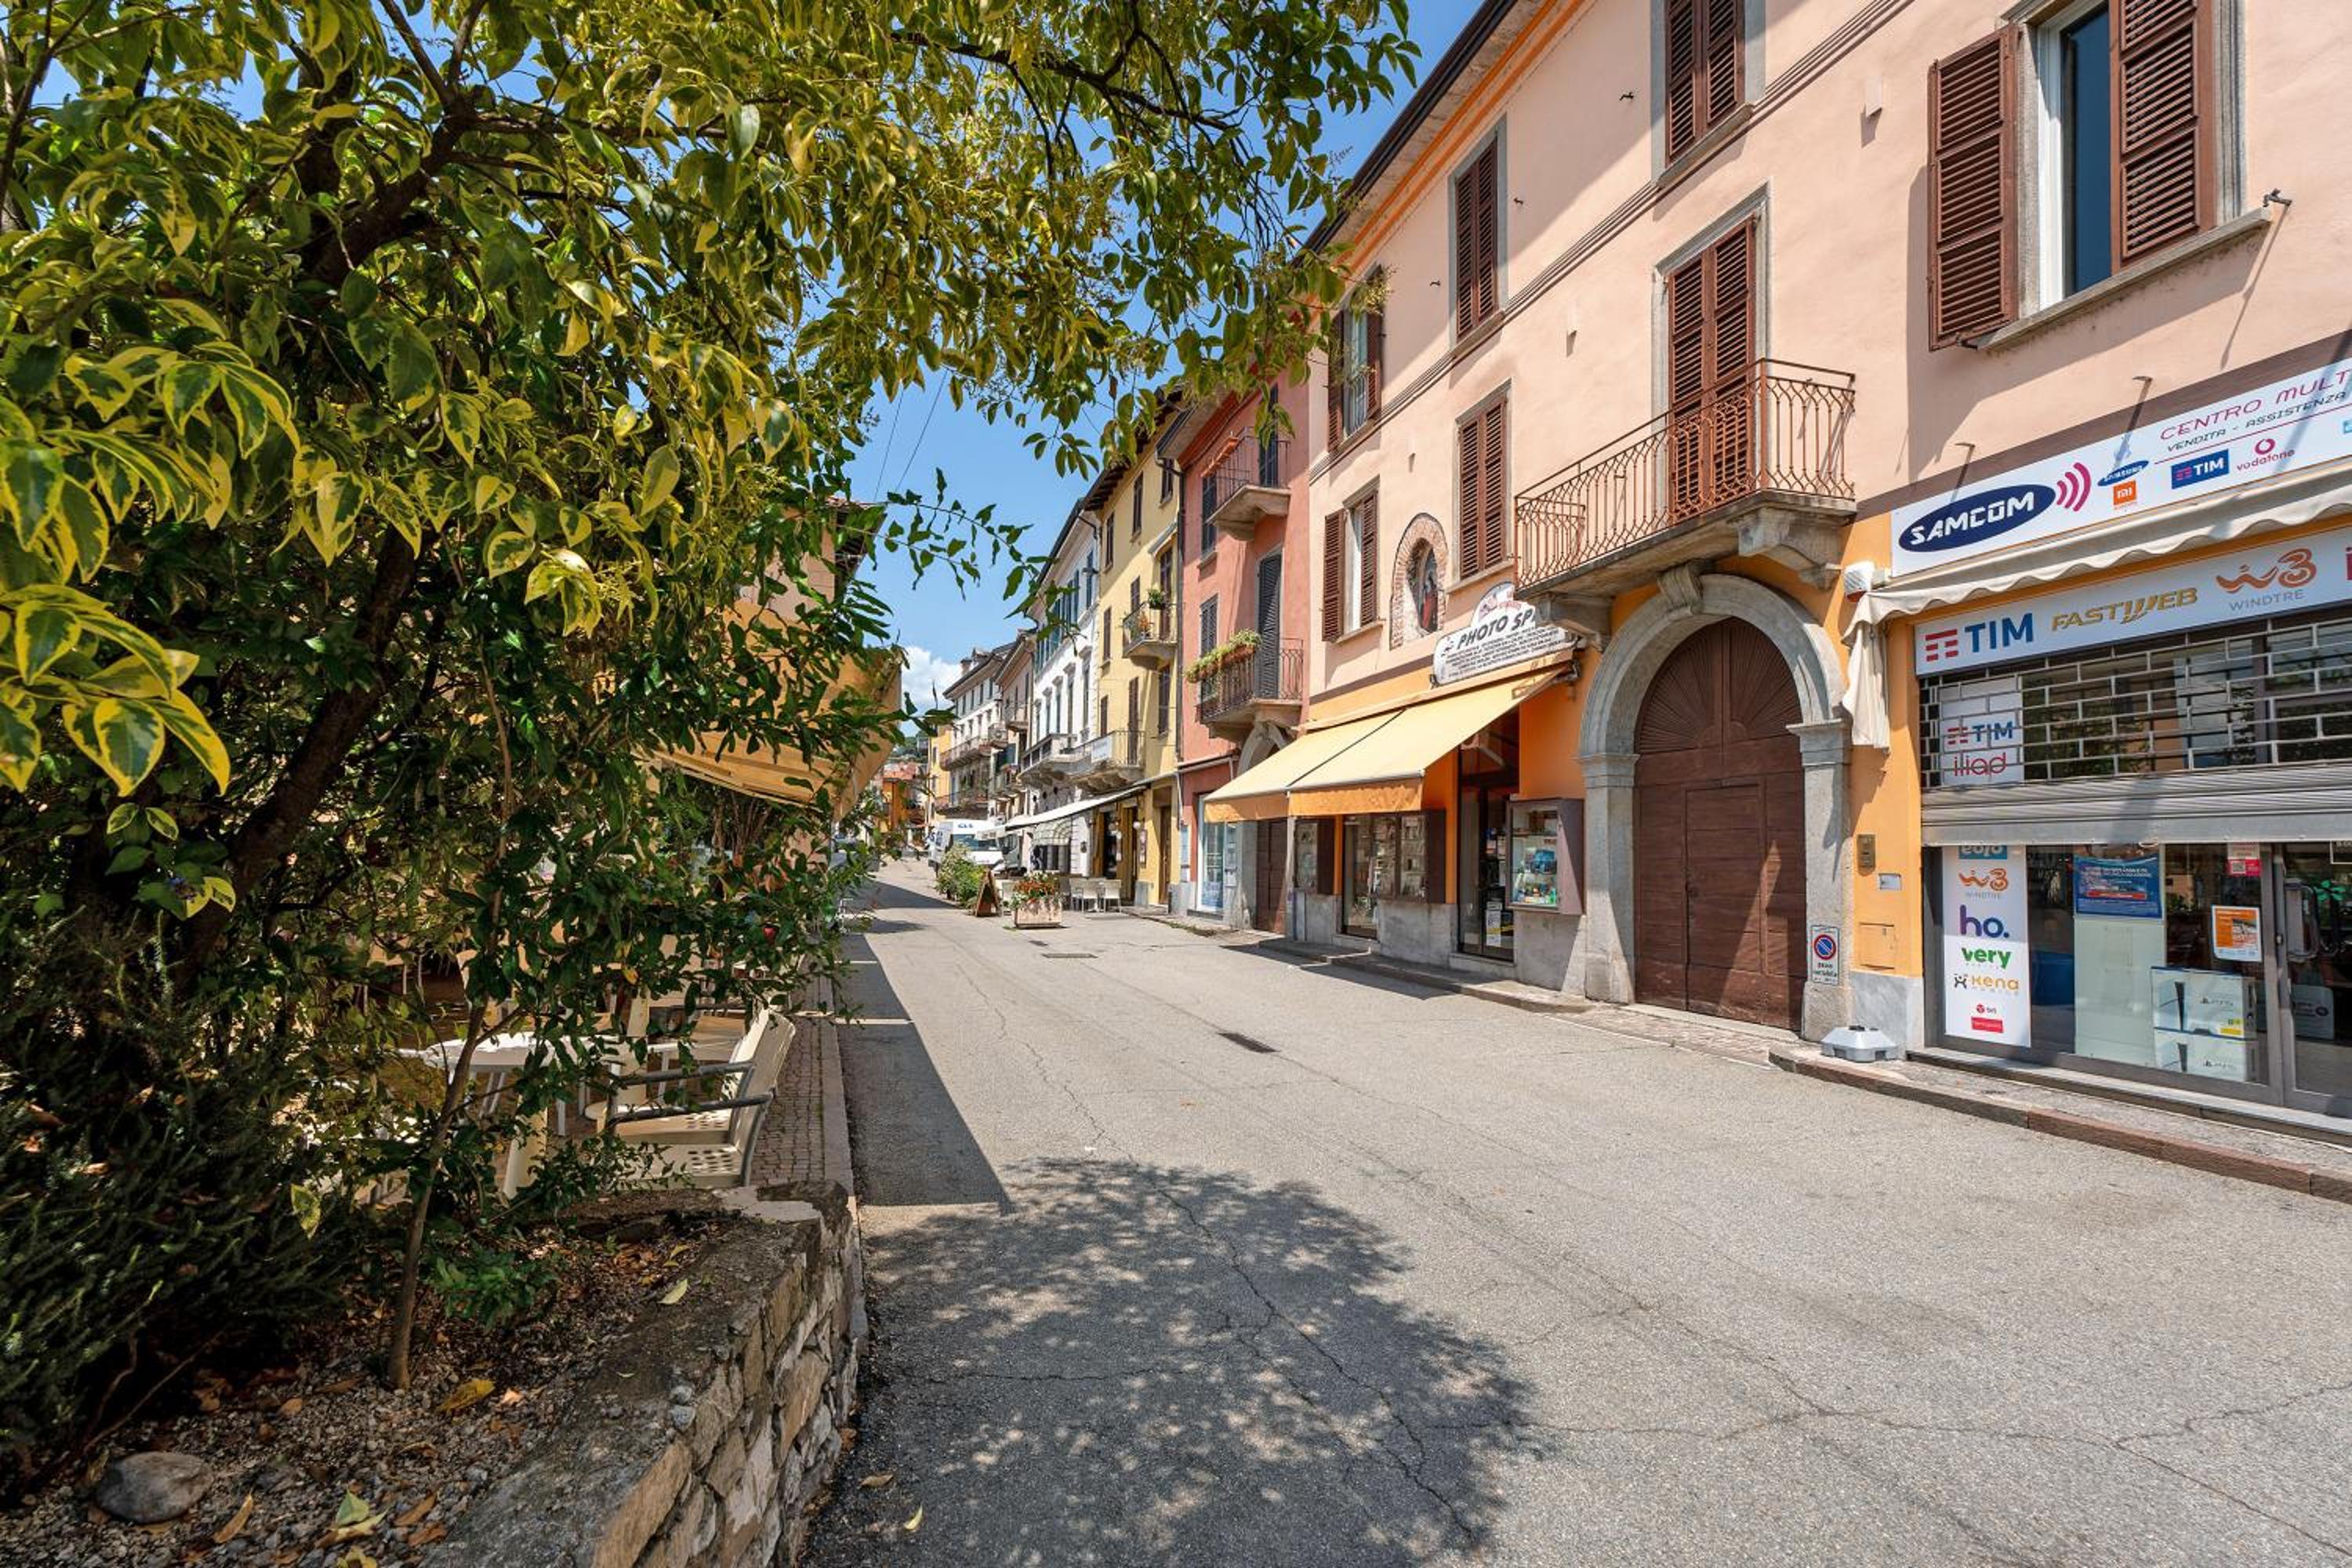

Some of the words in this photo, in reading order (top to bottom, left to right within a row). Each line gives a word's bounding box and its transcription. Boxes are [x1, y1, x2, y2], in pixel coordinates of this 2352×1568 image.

[2160, 398, 2263, 441] CENTRO
[2167, 428, 2227, 452] VENDITA
[2245, 390, 2347, 429] ASSISTENZA
[2193, 457, 2224, 476] TIM
[2236, 448, 2295, 471] vodafone
[1911, 492, 2035, 546] SAMCOM
[2229, 589, 2305, 612] WINDTRE
[1457, 615, 1509, 650] PHOTO
[1512, 608, 1536, 632] SP
[1965, 612, 2033, 653] TIM
[2052, 587, 2198, 632] FASTWEB
[1972, 720, 2013, 742] TIM
[1954, 752, 2006, 777] iliad
[1961, 947, 2013, 970] very
